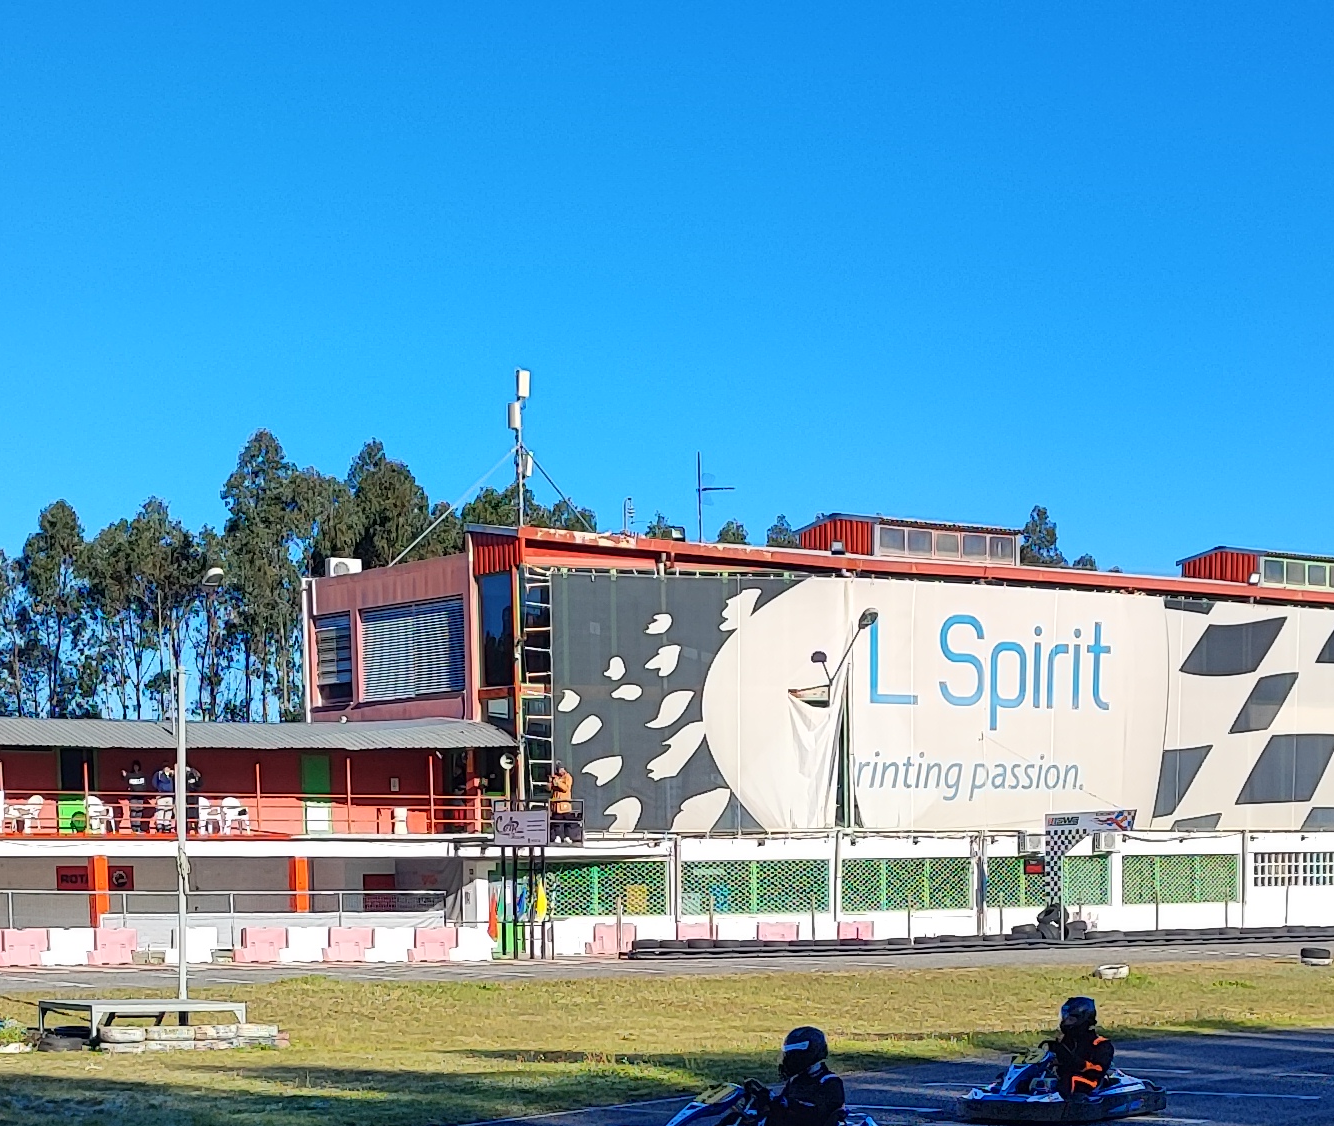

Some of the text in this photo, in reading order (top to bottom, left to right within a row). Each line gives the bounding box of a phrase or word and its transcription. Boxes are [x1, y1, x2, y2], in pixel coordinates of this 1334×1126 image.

[939, 614, 1111, 731] Spirit
[853, 751, 1084, 801] rinting passion.
